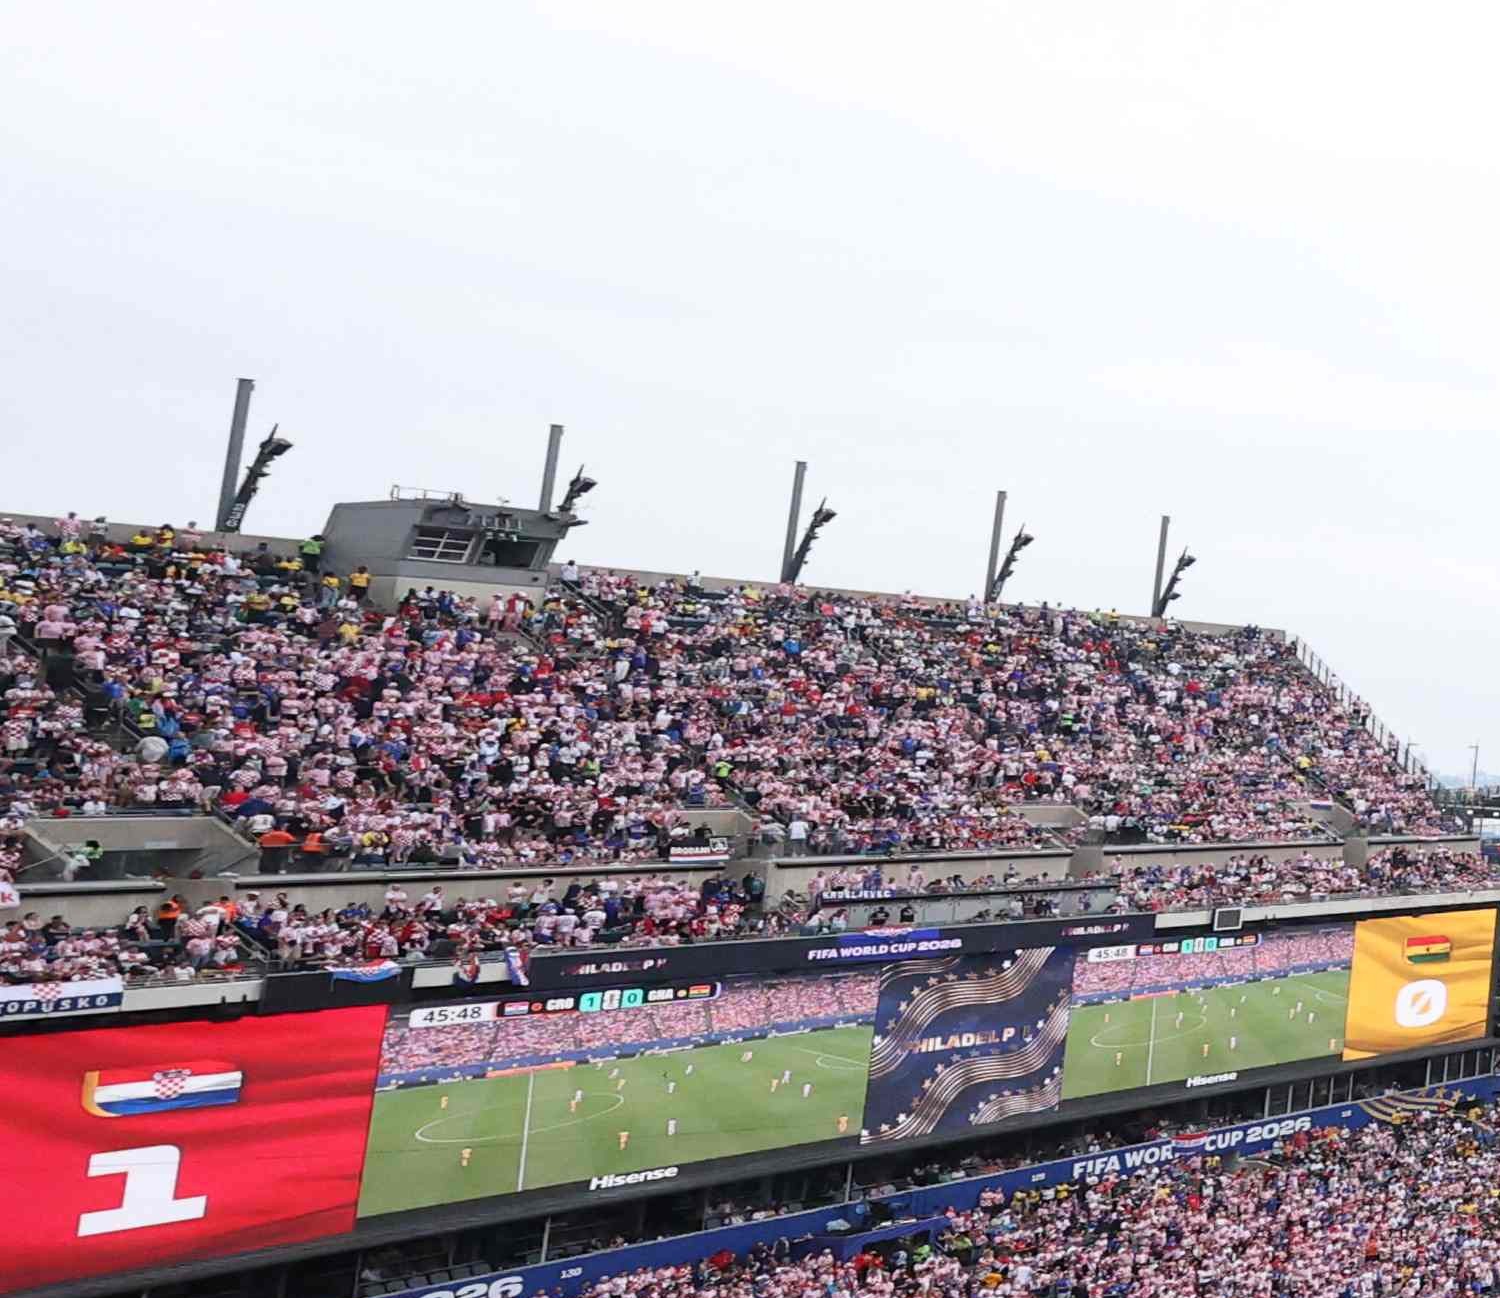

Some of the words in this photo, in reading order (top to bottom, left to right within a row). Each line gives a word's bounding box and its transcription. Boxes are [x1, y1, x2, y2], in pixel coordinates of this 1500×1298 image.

[808, 948, 839, 960] FIFA
[840, 945, 888, 958] WORLD
[890, 943, 918, 955] CUP
[423, 1006, 482, 1023] 45:48
[1185, 1071, 1239, 1089] Hisense
[1072, 1155, 1122, 1181] FIFA
[1204, 1130, 1244, 1151] CUP
[1246, 1116, 1312, 1143] 2026
[588, 1164, 680, 1193] Hisense
[76, 1144, 207, 1237] 1
